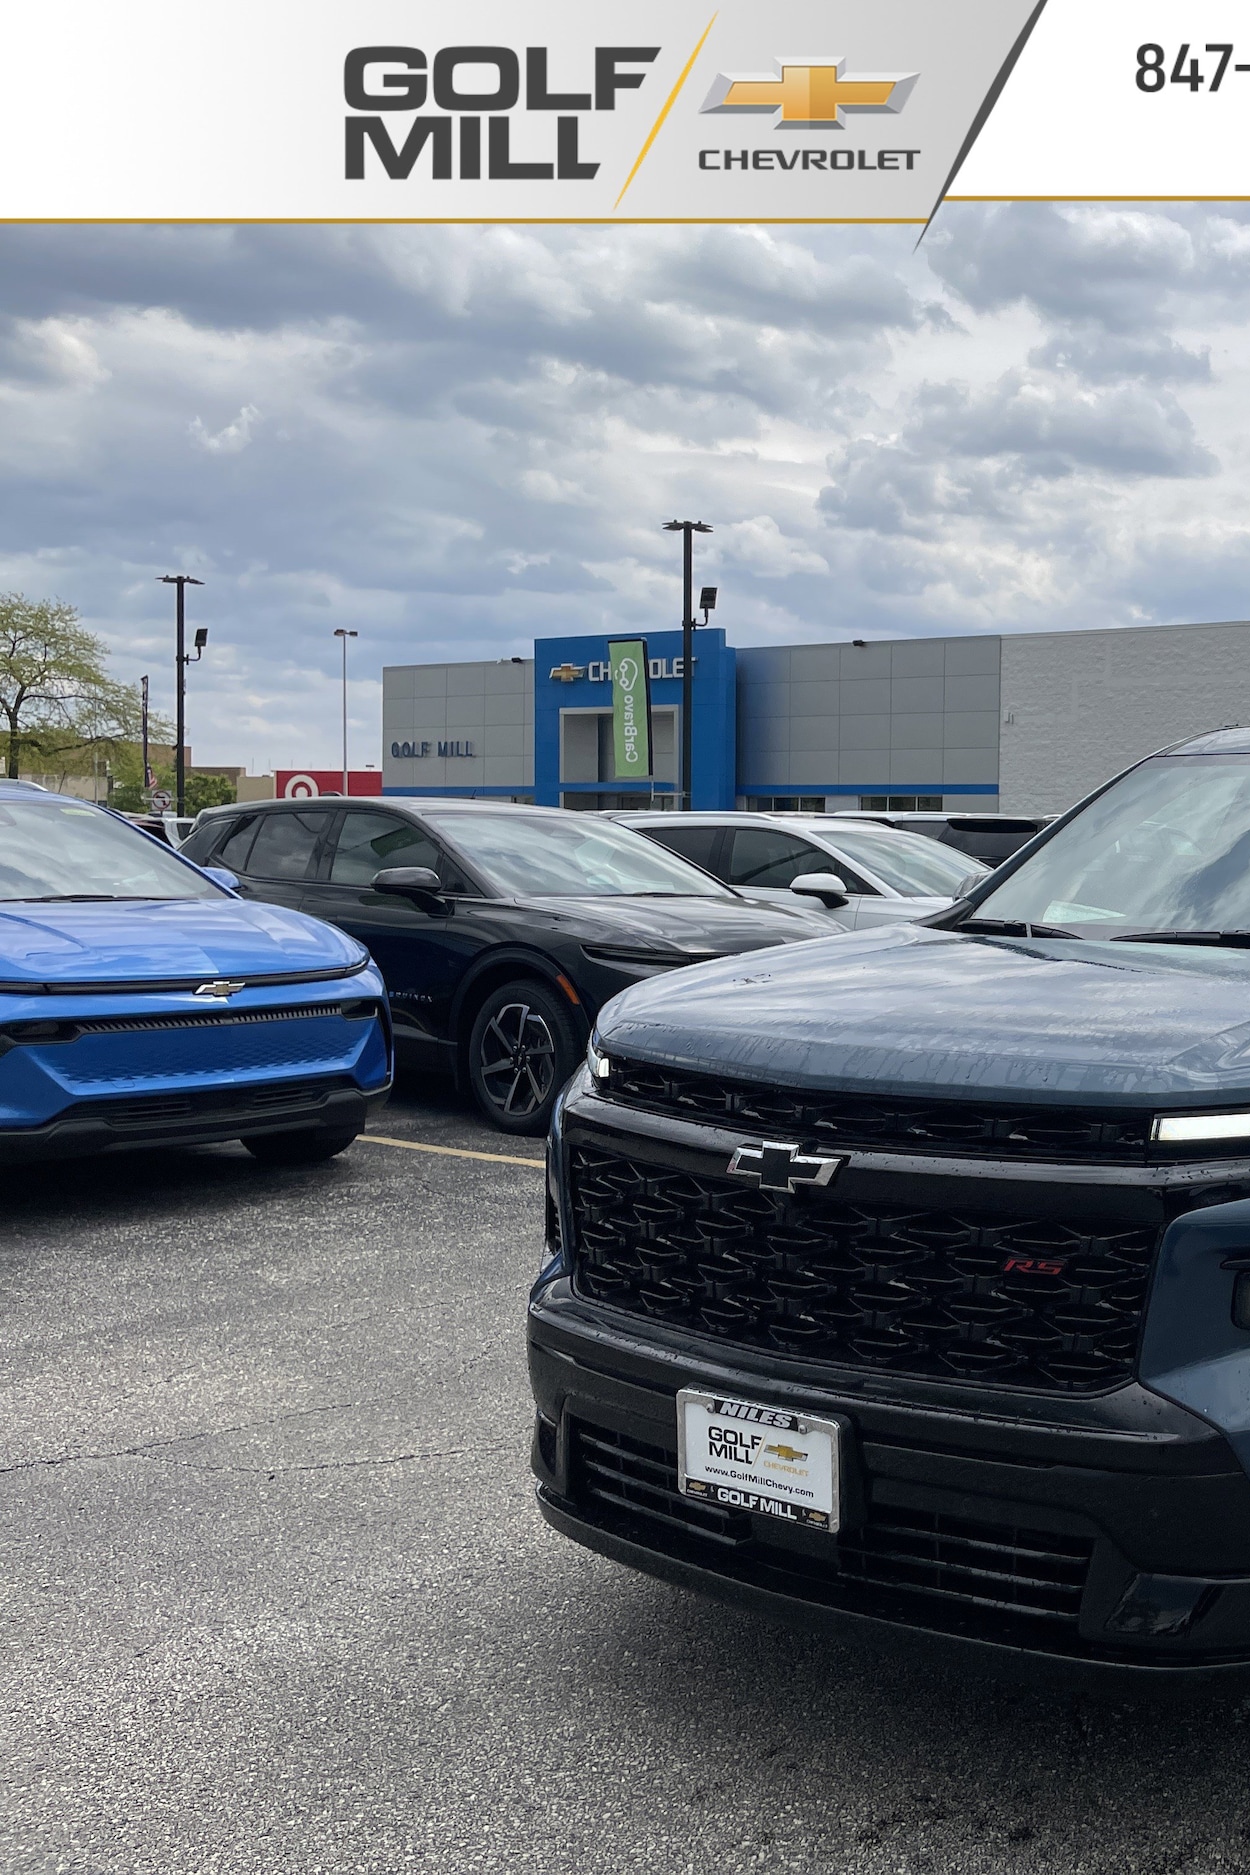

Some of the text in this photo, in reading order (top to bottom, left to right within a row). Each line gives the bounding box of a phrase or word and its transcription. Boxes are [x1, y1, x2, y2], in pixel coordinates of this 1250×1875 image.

[588, 656, 697, 682] CHOLE
[391, 741, 476, 758] GOLF MILL
[1004, 1257, 1065, 1275] RS
[719, 1402, 793, 1429] NILES
[708, 1426, 762, 1450] GOLF
[708, 1442, 753, 1465] MILL
[763, 1460, 809, 1477] CHEVROLET
[705, 1465, 815, 1498] www.GolfMillChevy.com
[717, 1488, 798, 1520] GOLF MILL
